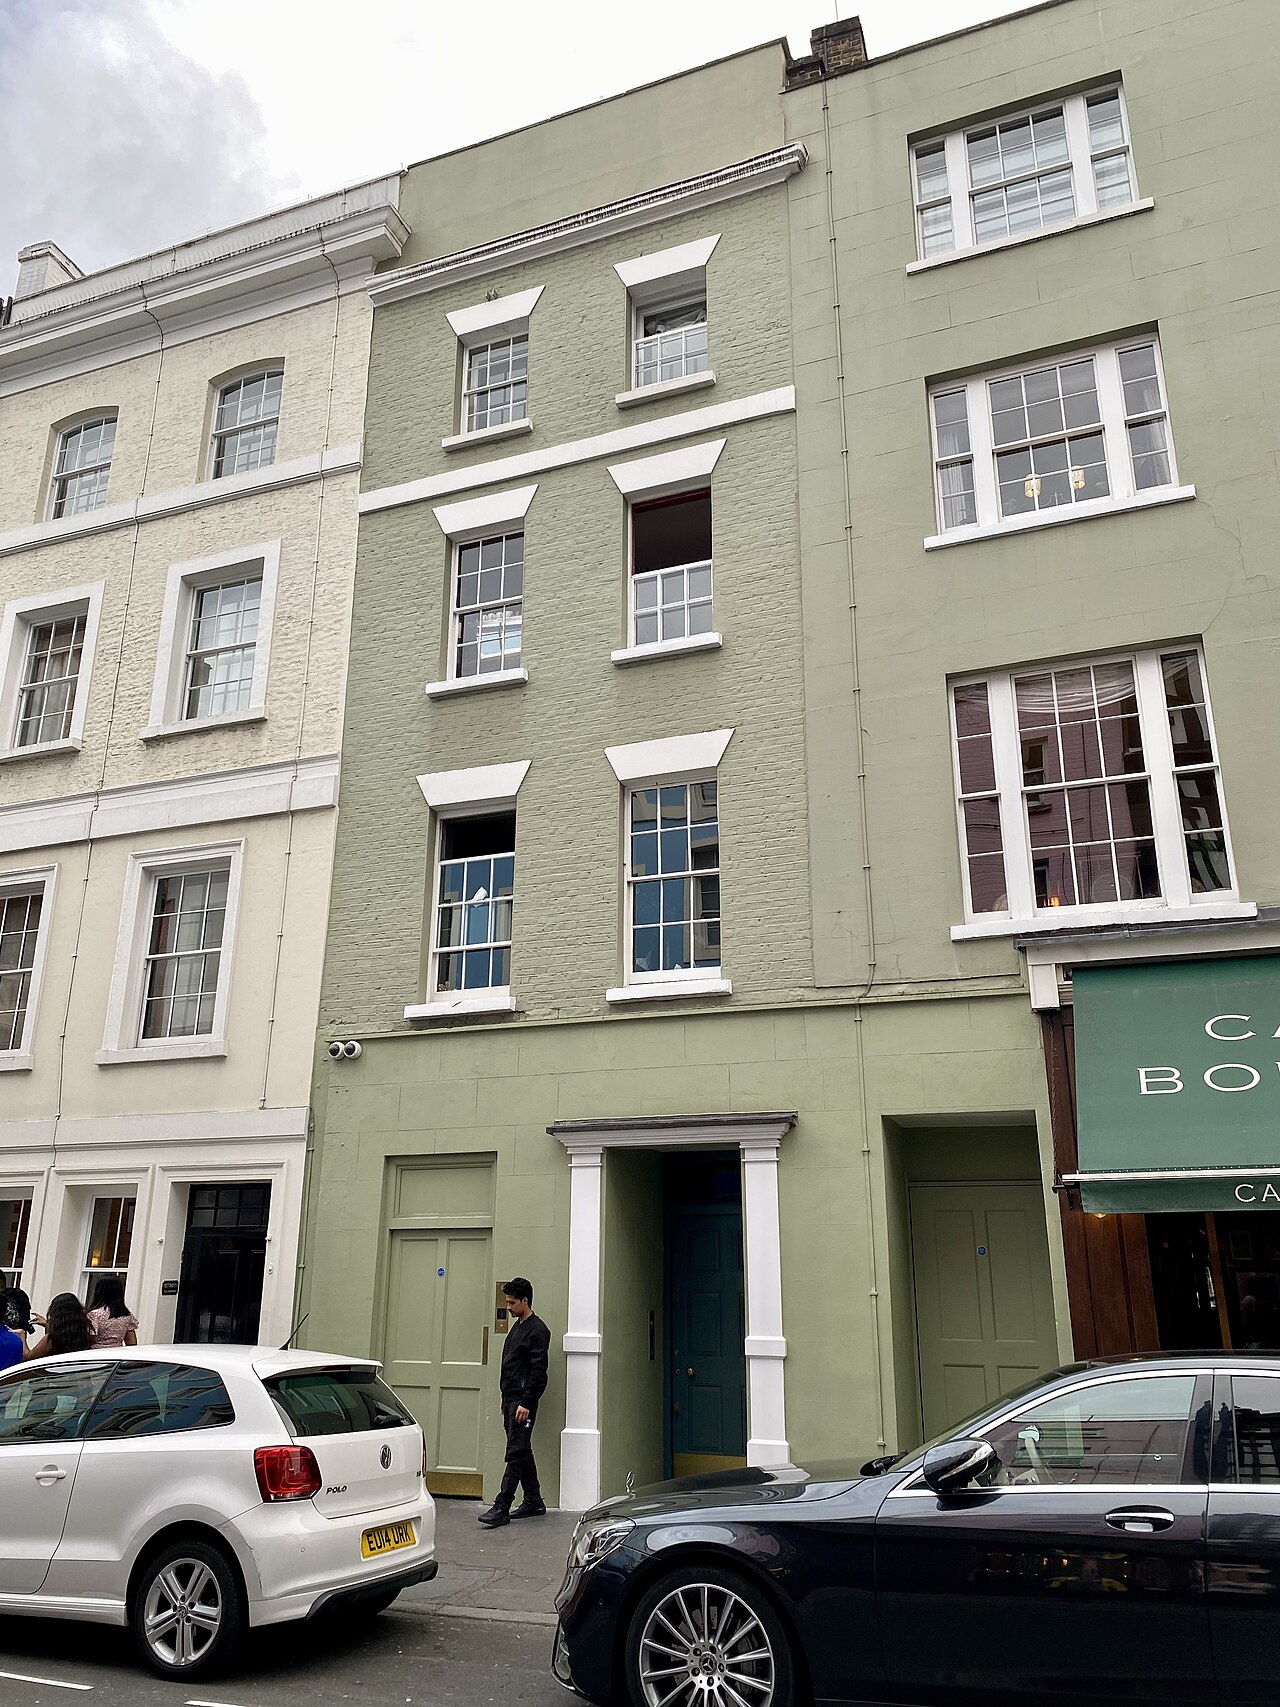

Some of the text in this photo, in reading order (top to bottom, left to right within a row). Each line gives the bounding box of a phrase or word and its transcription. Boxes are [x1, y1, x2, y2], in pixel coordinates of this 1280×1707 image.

[1204, 1014, 1280, 1041] C
[1137, 1061, 1280, 1095] BO
[1234, 1183, 1280, 1203] CA
[326, 1485, 348, 1495] POLO
[366, 1525, 411, 1551] EU14 URK
